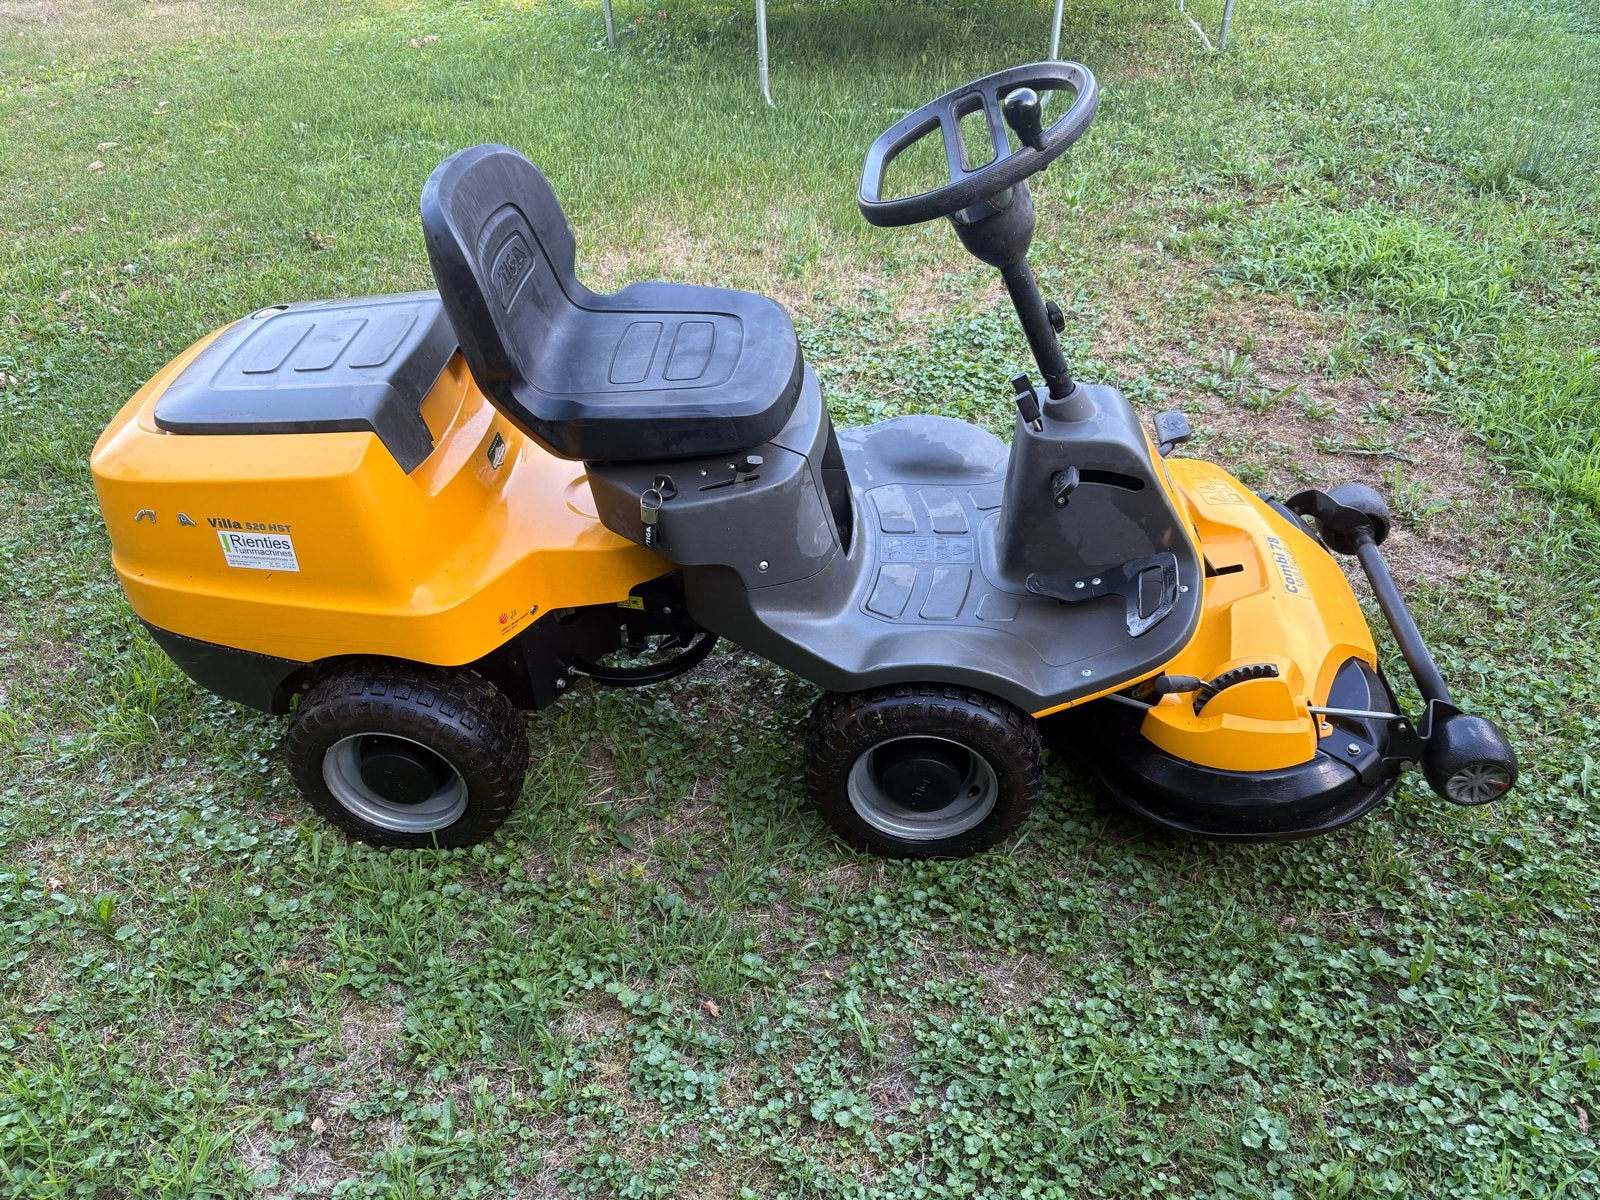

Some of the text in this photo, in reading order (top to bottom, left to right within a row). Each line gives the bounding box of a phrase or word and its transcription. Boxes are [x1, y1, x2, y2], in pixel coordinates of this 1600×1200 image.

[206, 517, 292, 533] Villa 520 HST
[229, 534, 291, 550] Rienties
[233, 546, 293, 557] Tuinmachines
[1266, 536, 1299, 593] Combi 78
